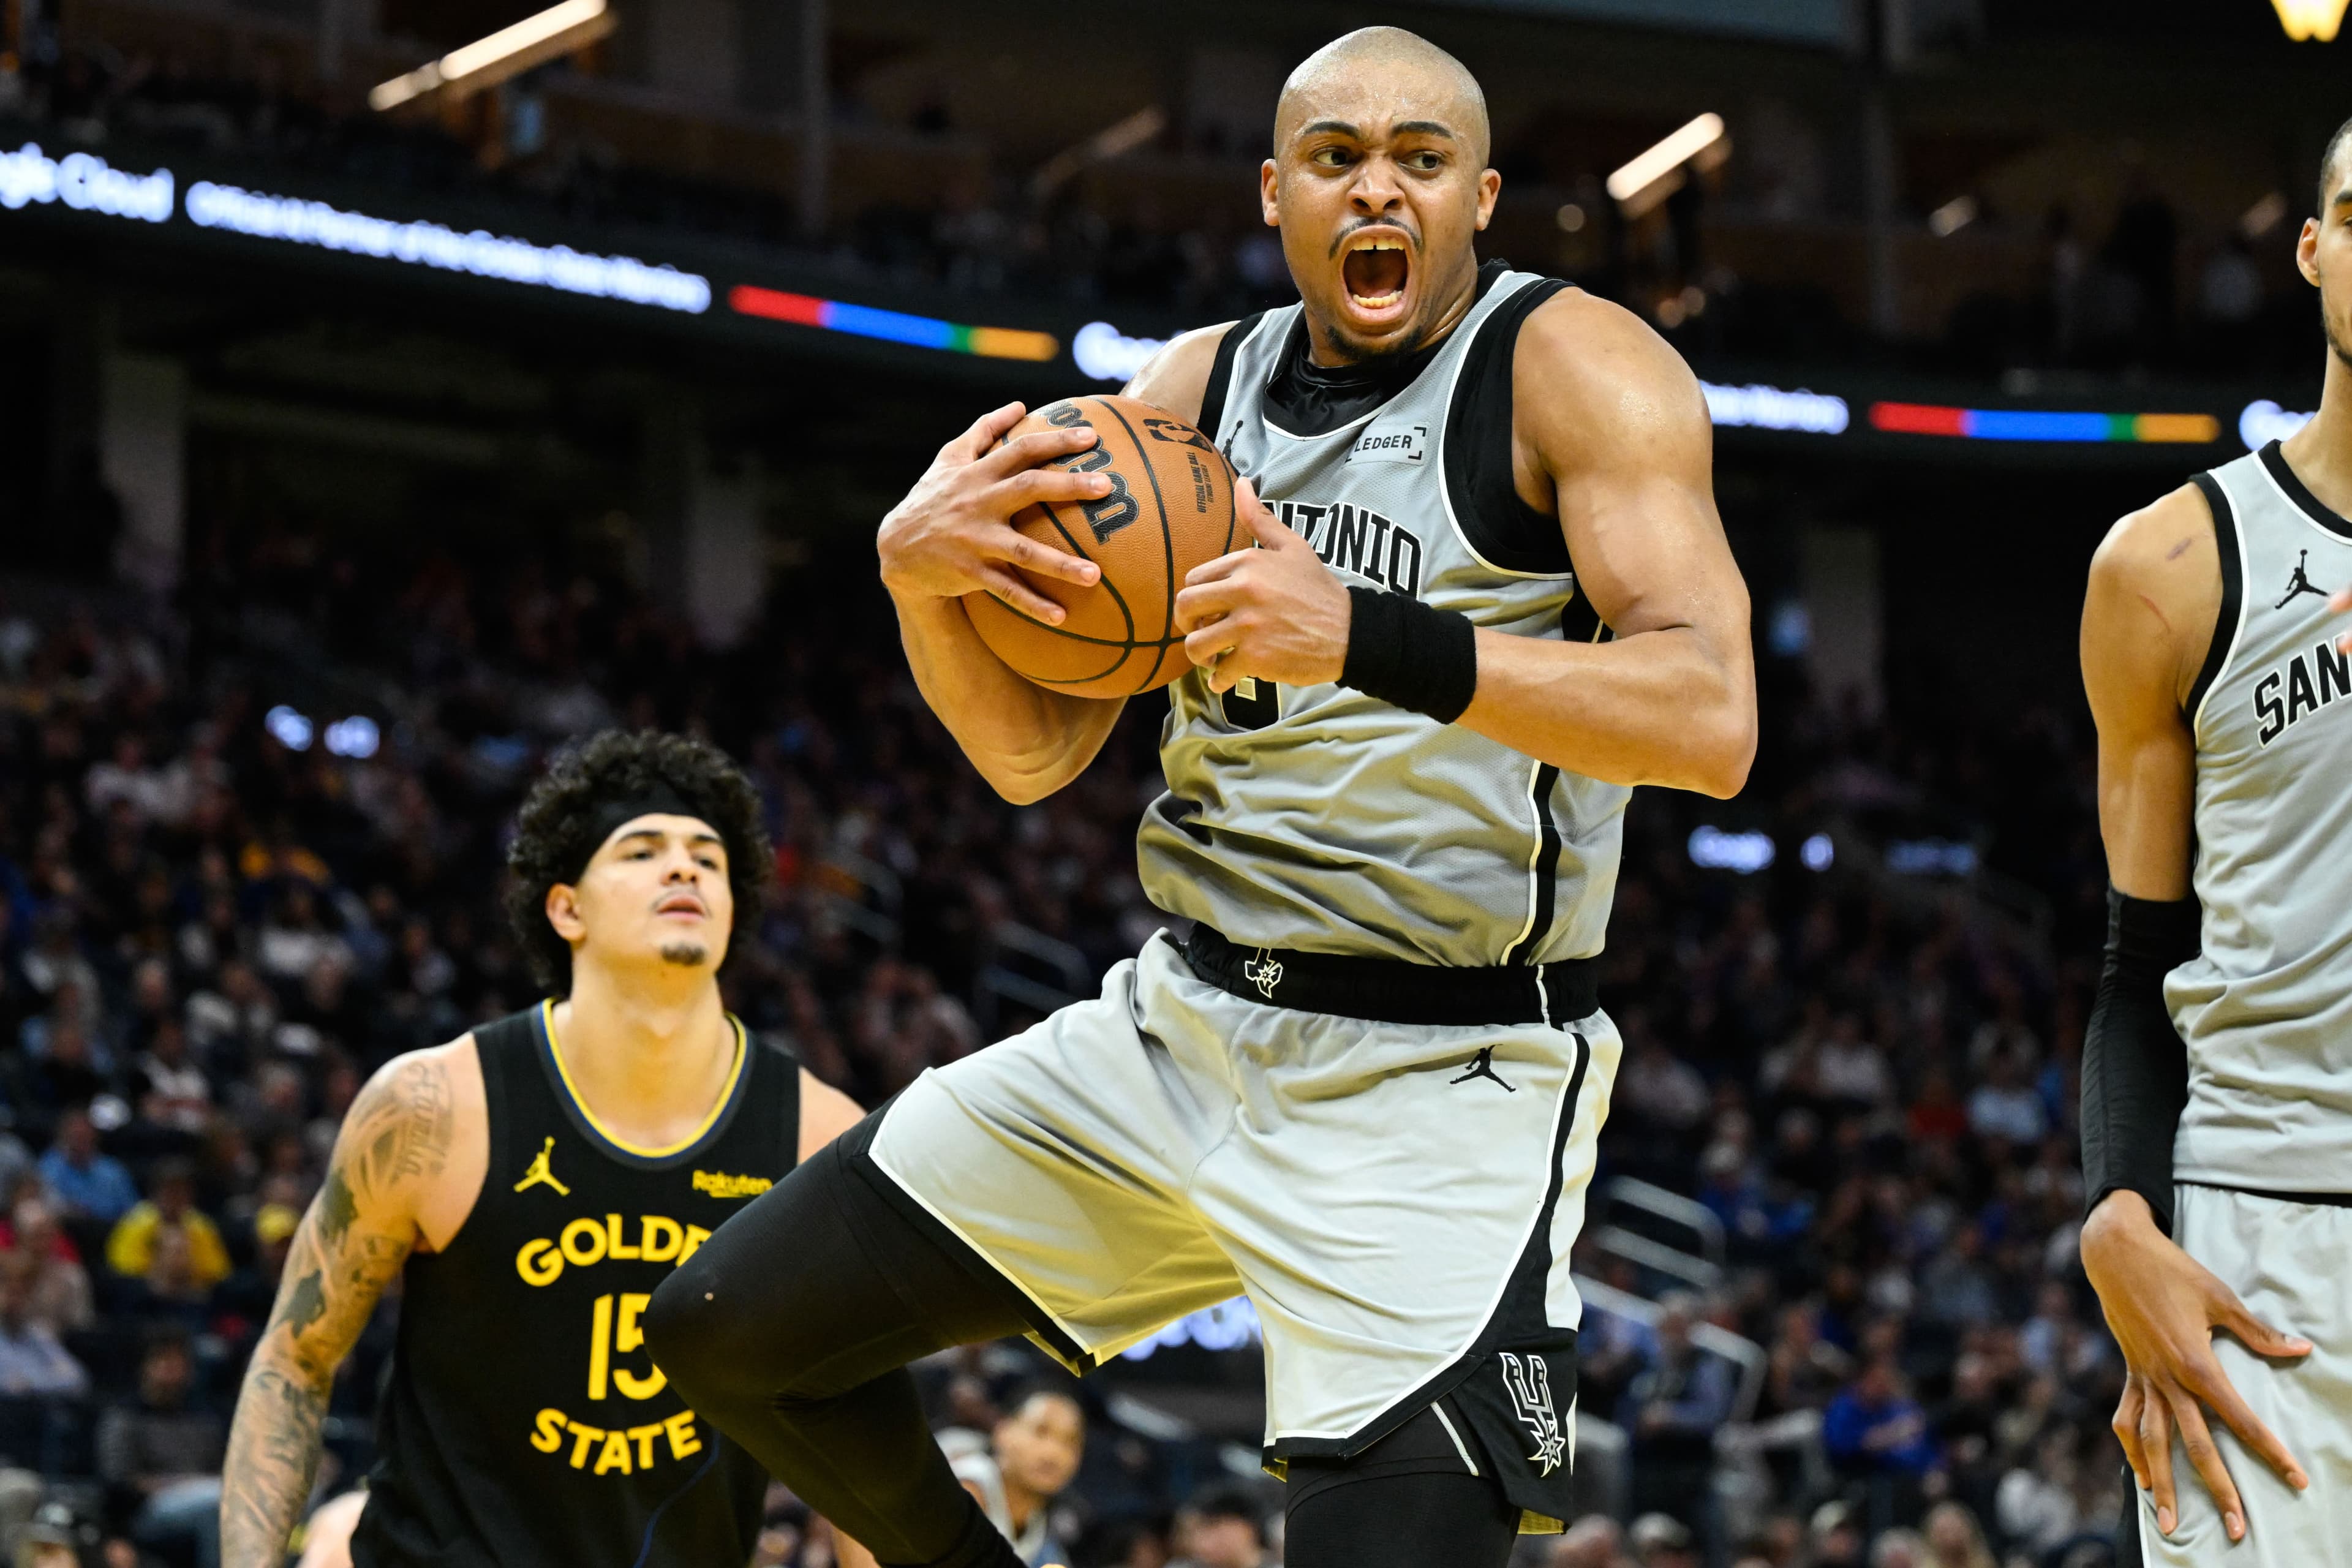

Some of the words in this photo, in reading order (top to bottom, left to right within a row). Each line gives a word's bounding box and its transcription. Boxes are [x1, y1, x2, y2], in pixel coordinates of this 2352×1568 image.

[1354, 435, 1412, 453] LEDGER
[1253, 500, 1424, 600] NTONIO
[2252, 633, 2352, 749] SAN
[692, 1169, 773, 1197] Rakuten
[516, 1213, 713, 1287] GOLDE
[588, 1293, 668, 1401] 15
[530, 1408, 703, 1476] STATE
